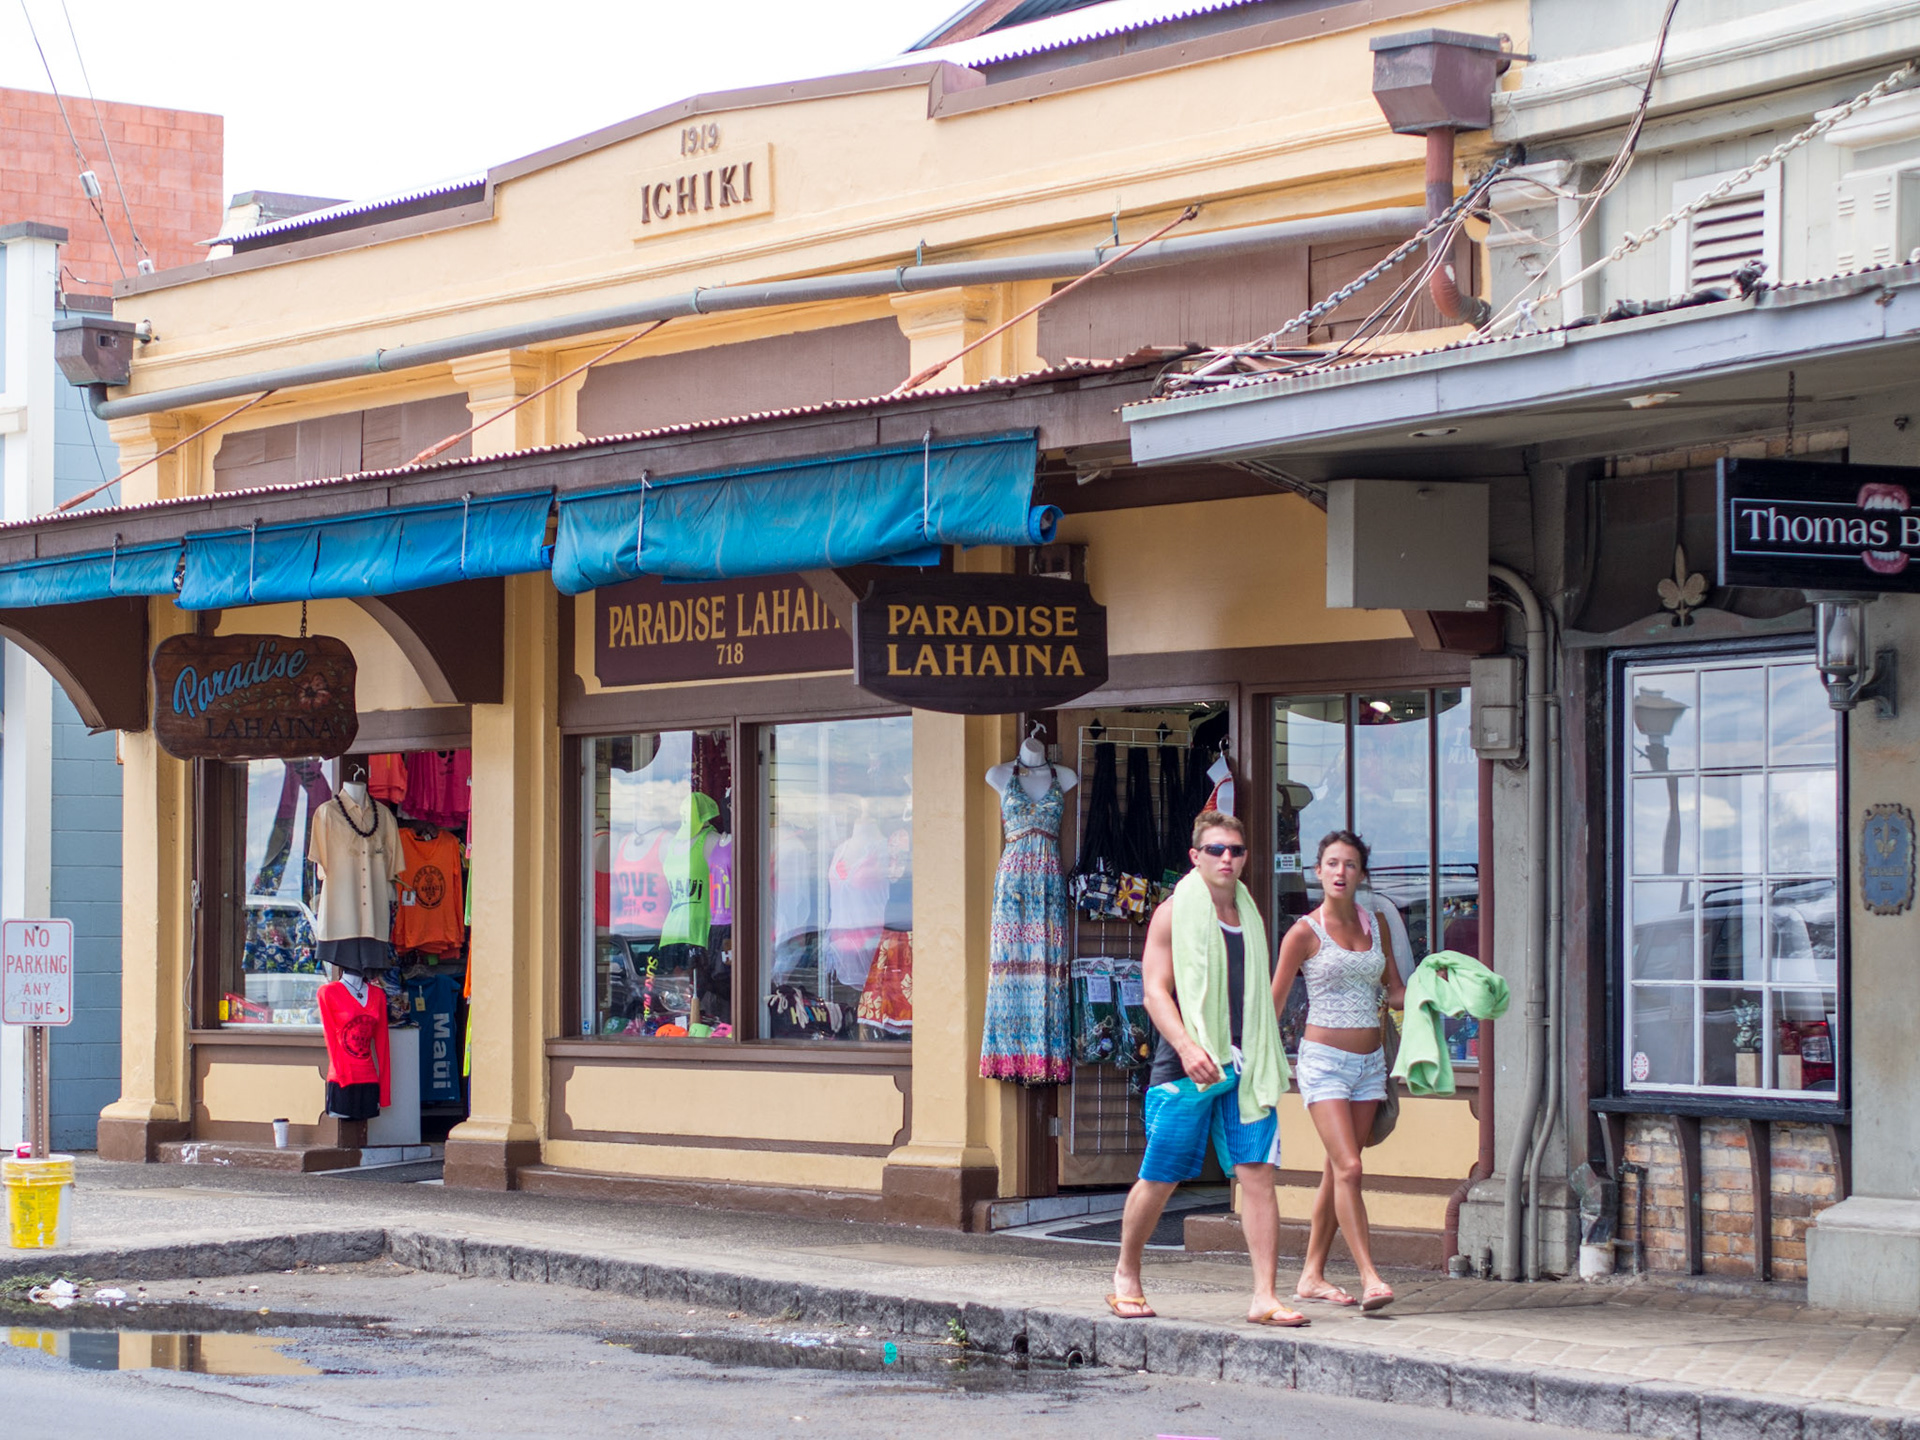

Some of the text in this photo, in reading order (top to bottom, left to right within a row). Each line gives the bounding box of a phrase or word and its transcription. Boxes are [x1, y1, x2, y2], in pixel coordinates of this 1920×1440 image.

[680, 123, 719, 156] 1919
[640, 161, 754, 225] ICHIKI
[1741, 507, 1889, 546] Thomas
[608, 595, 726, 648] PARADISE
[887, 605, 1079, 636] PARADISE
[716, 643, 744, 665] 718
[887, 644, 1086, 677] LAHAINA
[172, 641, 309, 719] Paradise
[206, 717, 338, 740] LAHAINA
[24, 928, 50, 947] NO
[6, 955, 68, 974] PARKING
[23, 983, 51, 995] ANY
[21, 1002, 52, 1015] TIME
[433, 1013, 451, 1089] Maui
